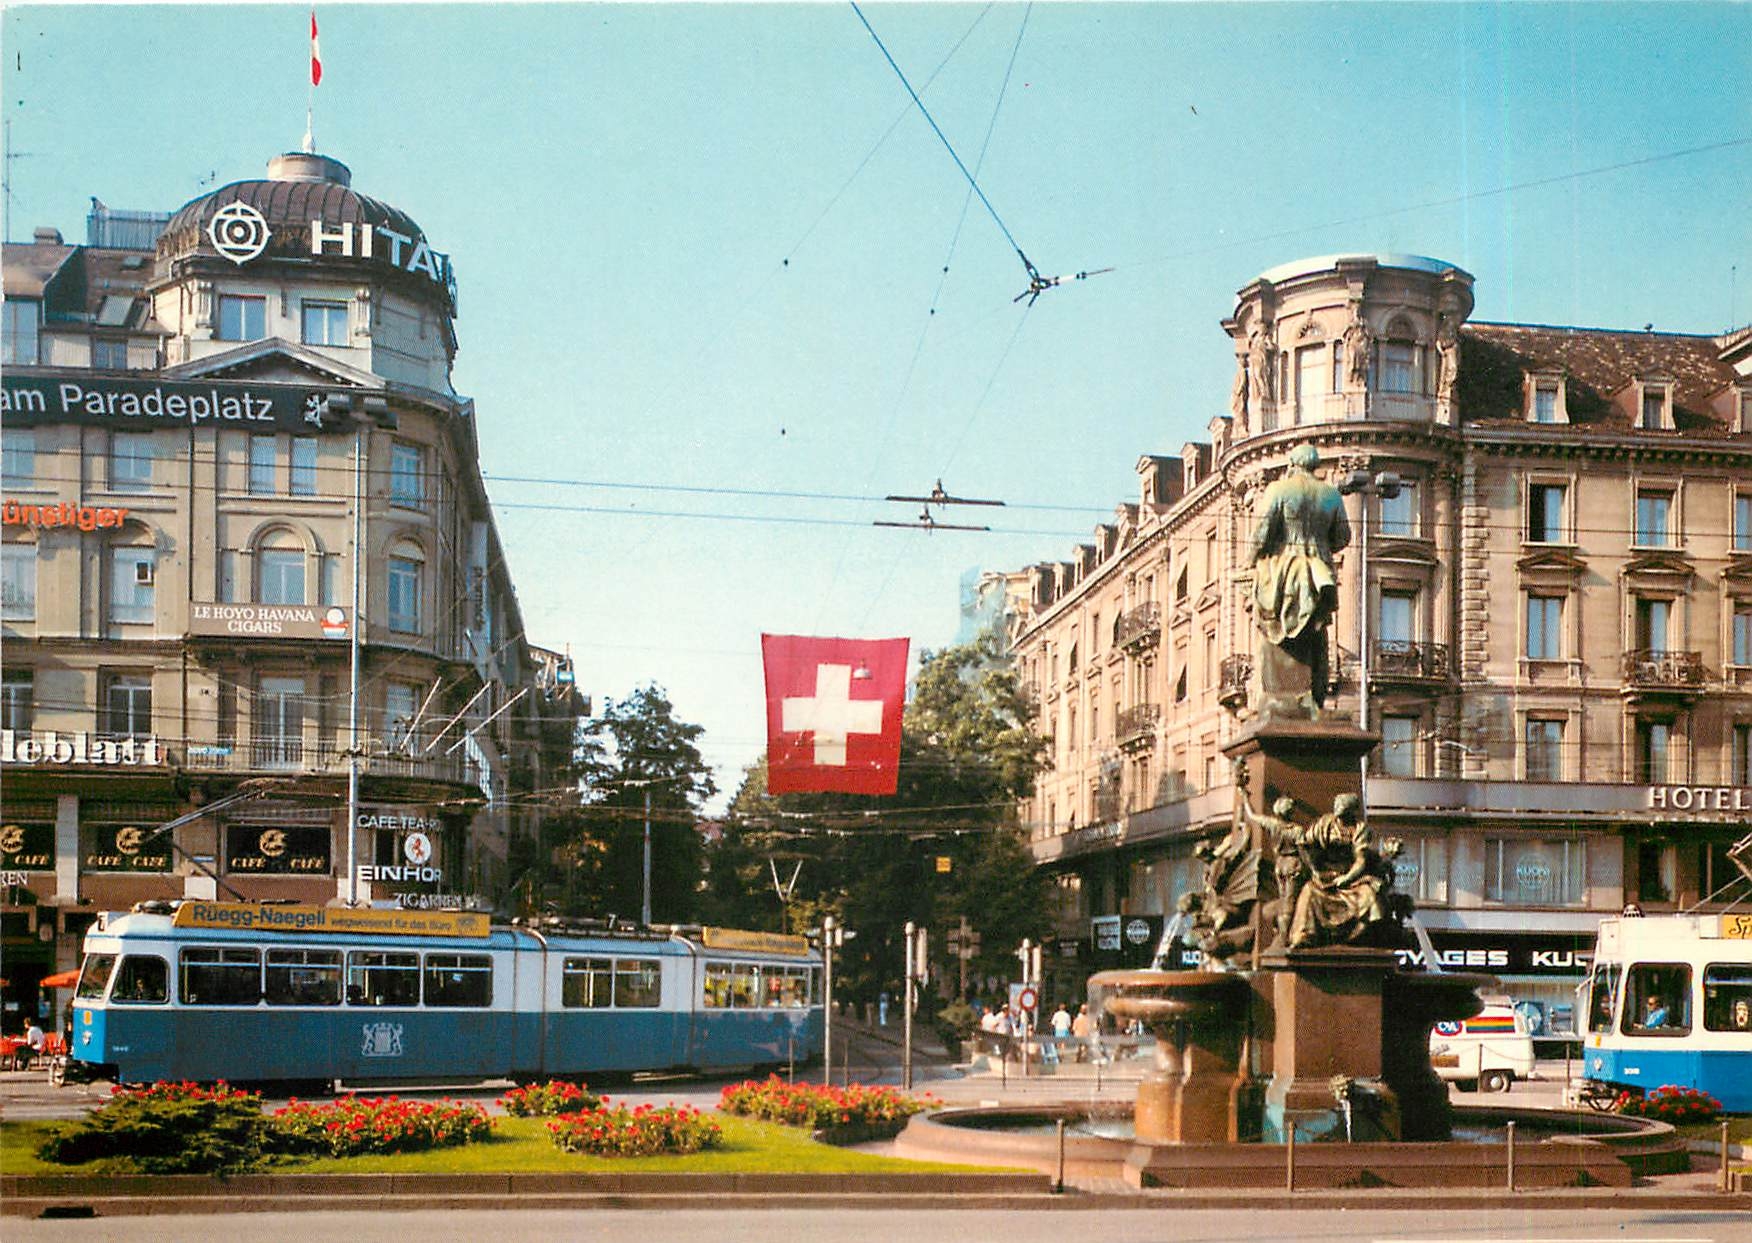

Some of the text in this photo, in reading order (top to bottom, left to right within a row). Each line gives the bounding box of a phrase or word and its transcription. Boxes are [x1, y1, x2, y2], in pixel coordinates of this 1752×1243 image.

[60, 384, 274, 423] Paradeplatz
[194, 606, 316, 622] LE HOYO HAVANA
[227, 620, 283, 634] CIGARS
[2, 730, 162, 766] leblatt
[1648, 786, 1750, 811] HOTEL
[193, 904, 326, 927] Rüegg-Naegeli
